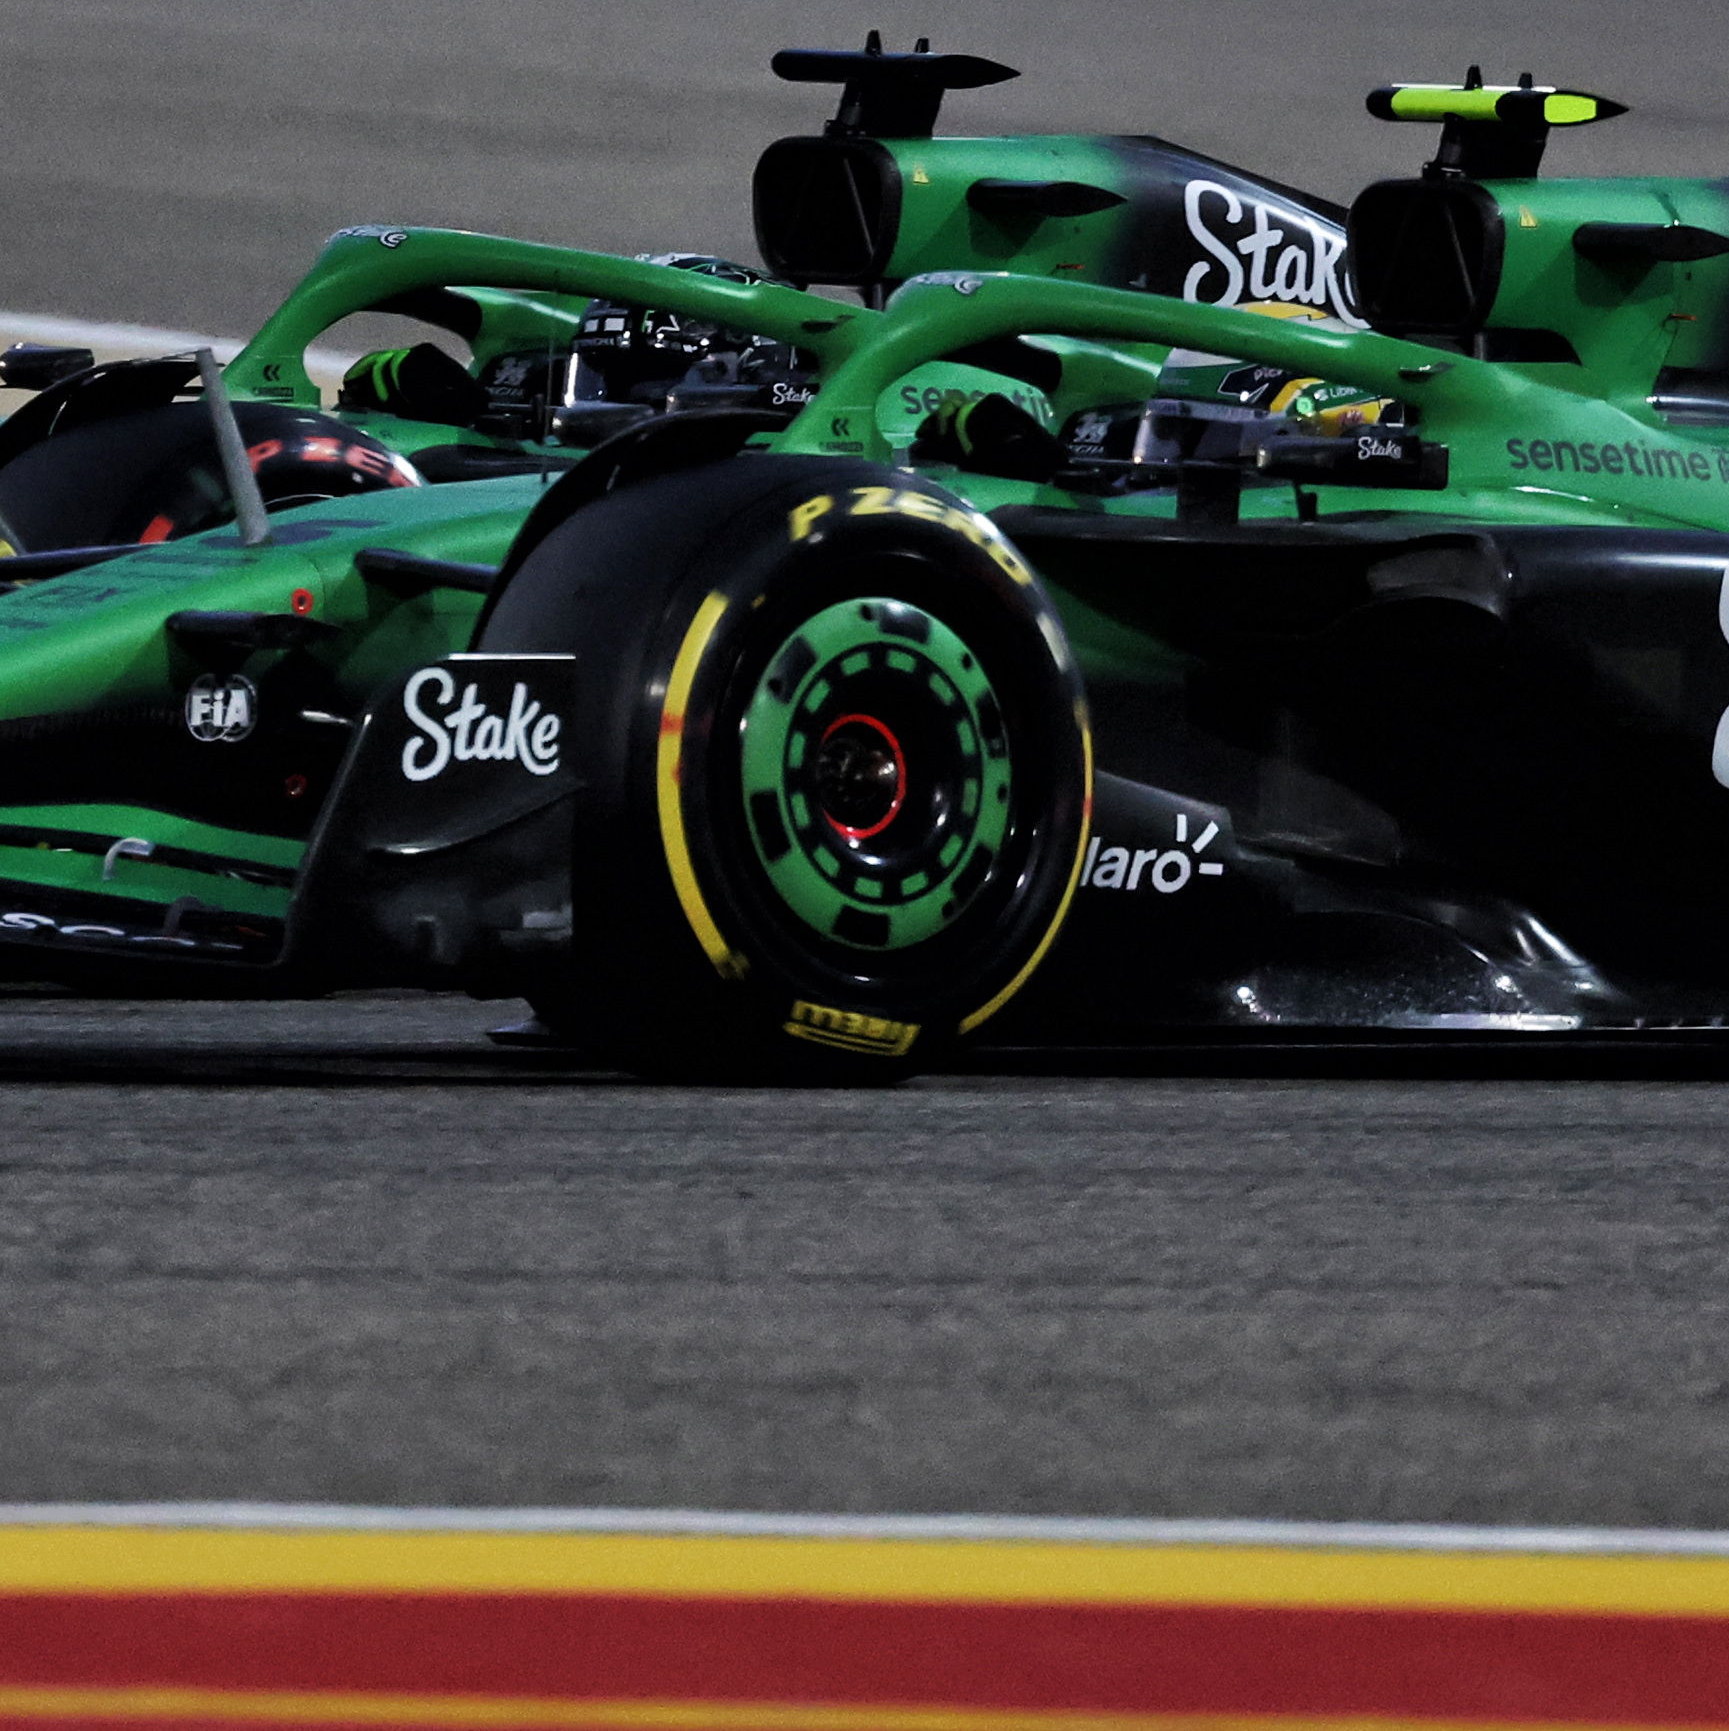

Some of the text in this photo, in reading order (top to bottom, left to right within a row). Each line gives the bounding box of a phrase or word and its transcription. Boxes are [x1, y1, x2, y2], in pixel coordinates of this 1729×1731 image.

[1183, 179, 1373, 330] Stak
[1358, 436, 1403, 461] Stake
[1506, 438, 1712, 482] sensetime
[787, 485, 1033, 587] P ZERO
[400, 665, 562, 783] Stake
[1078, 835, 1192, 894] laro
